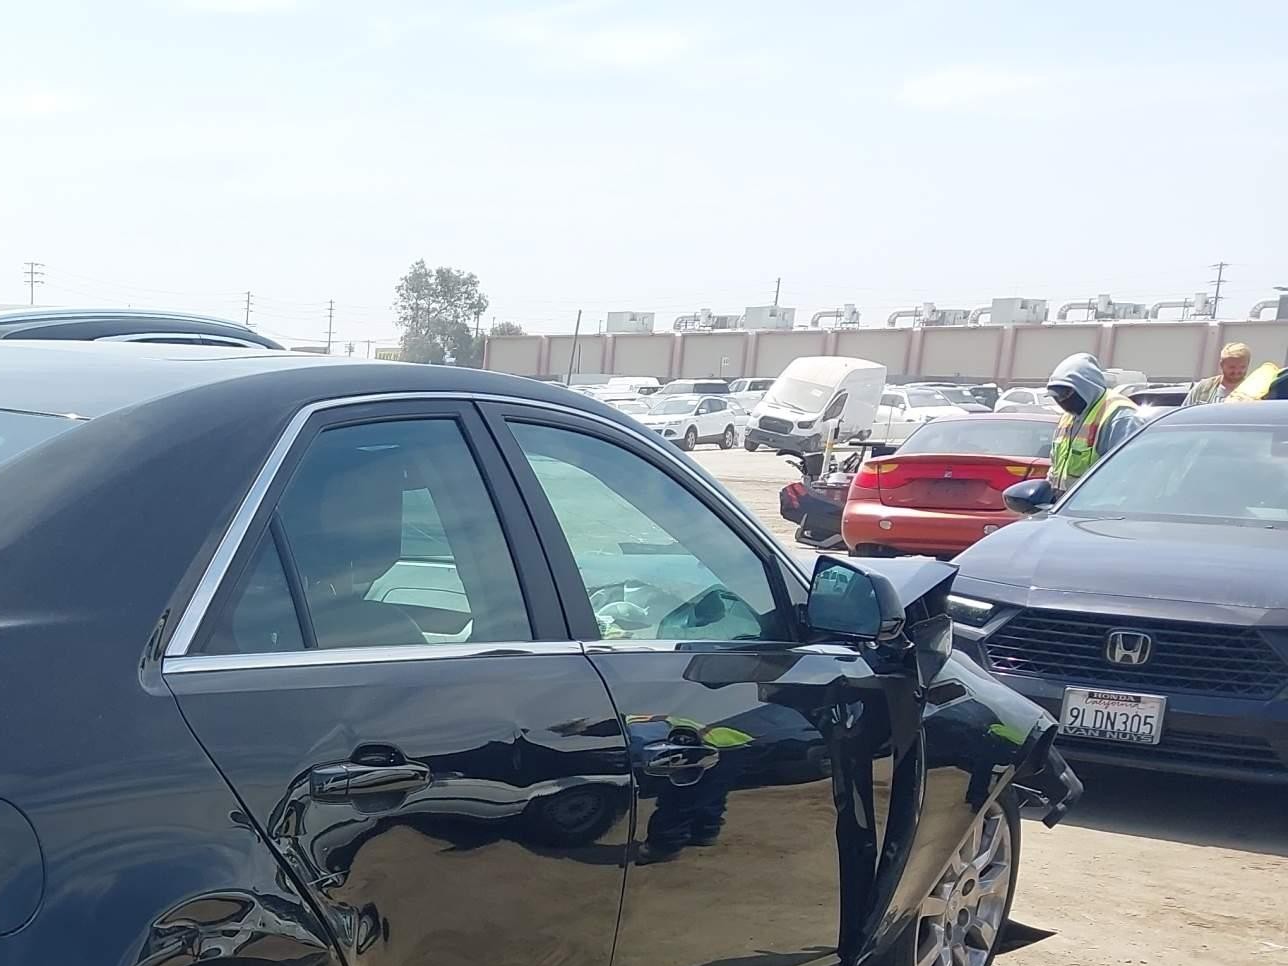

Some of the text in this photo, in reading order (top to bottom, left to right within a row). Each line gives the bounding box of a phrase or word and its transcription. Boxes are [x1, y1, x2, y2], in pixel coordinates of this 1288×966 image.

[1085, 698, 1142, 709] California
[1092, 692, 1135, 702] HONDA
[1068, 706, 1155, 735] 9LDN305
[1064, 727, 1153, 742] VAN NUYS
